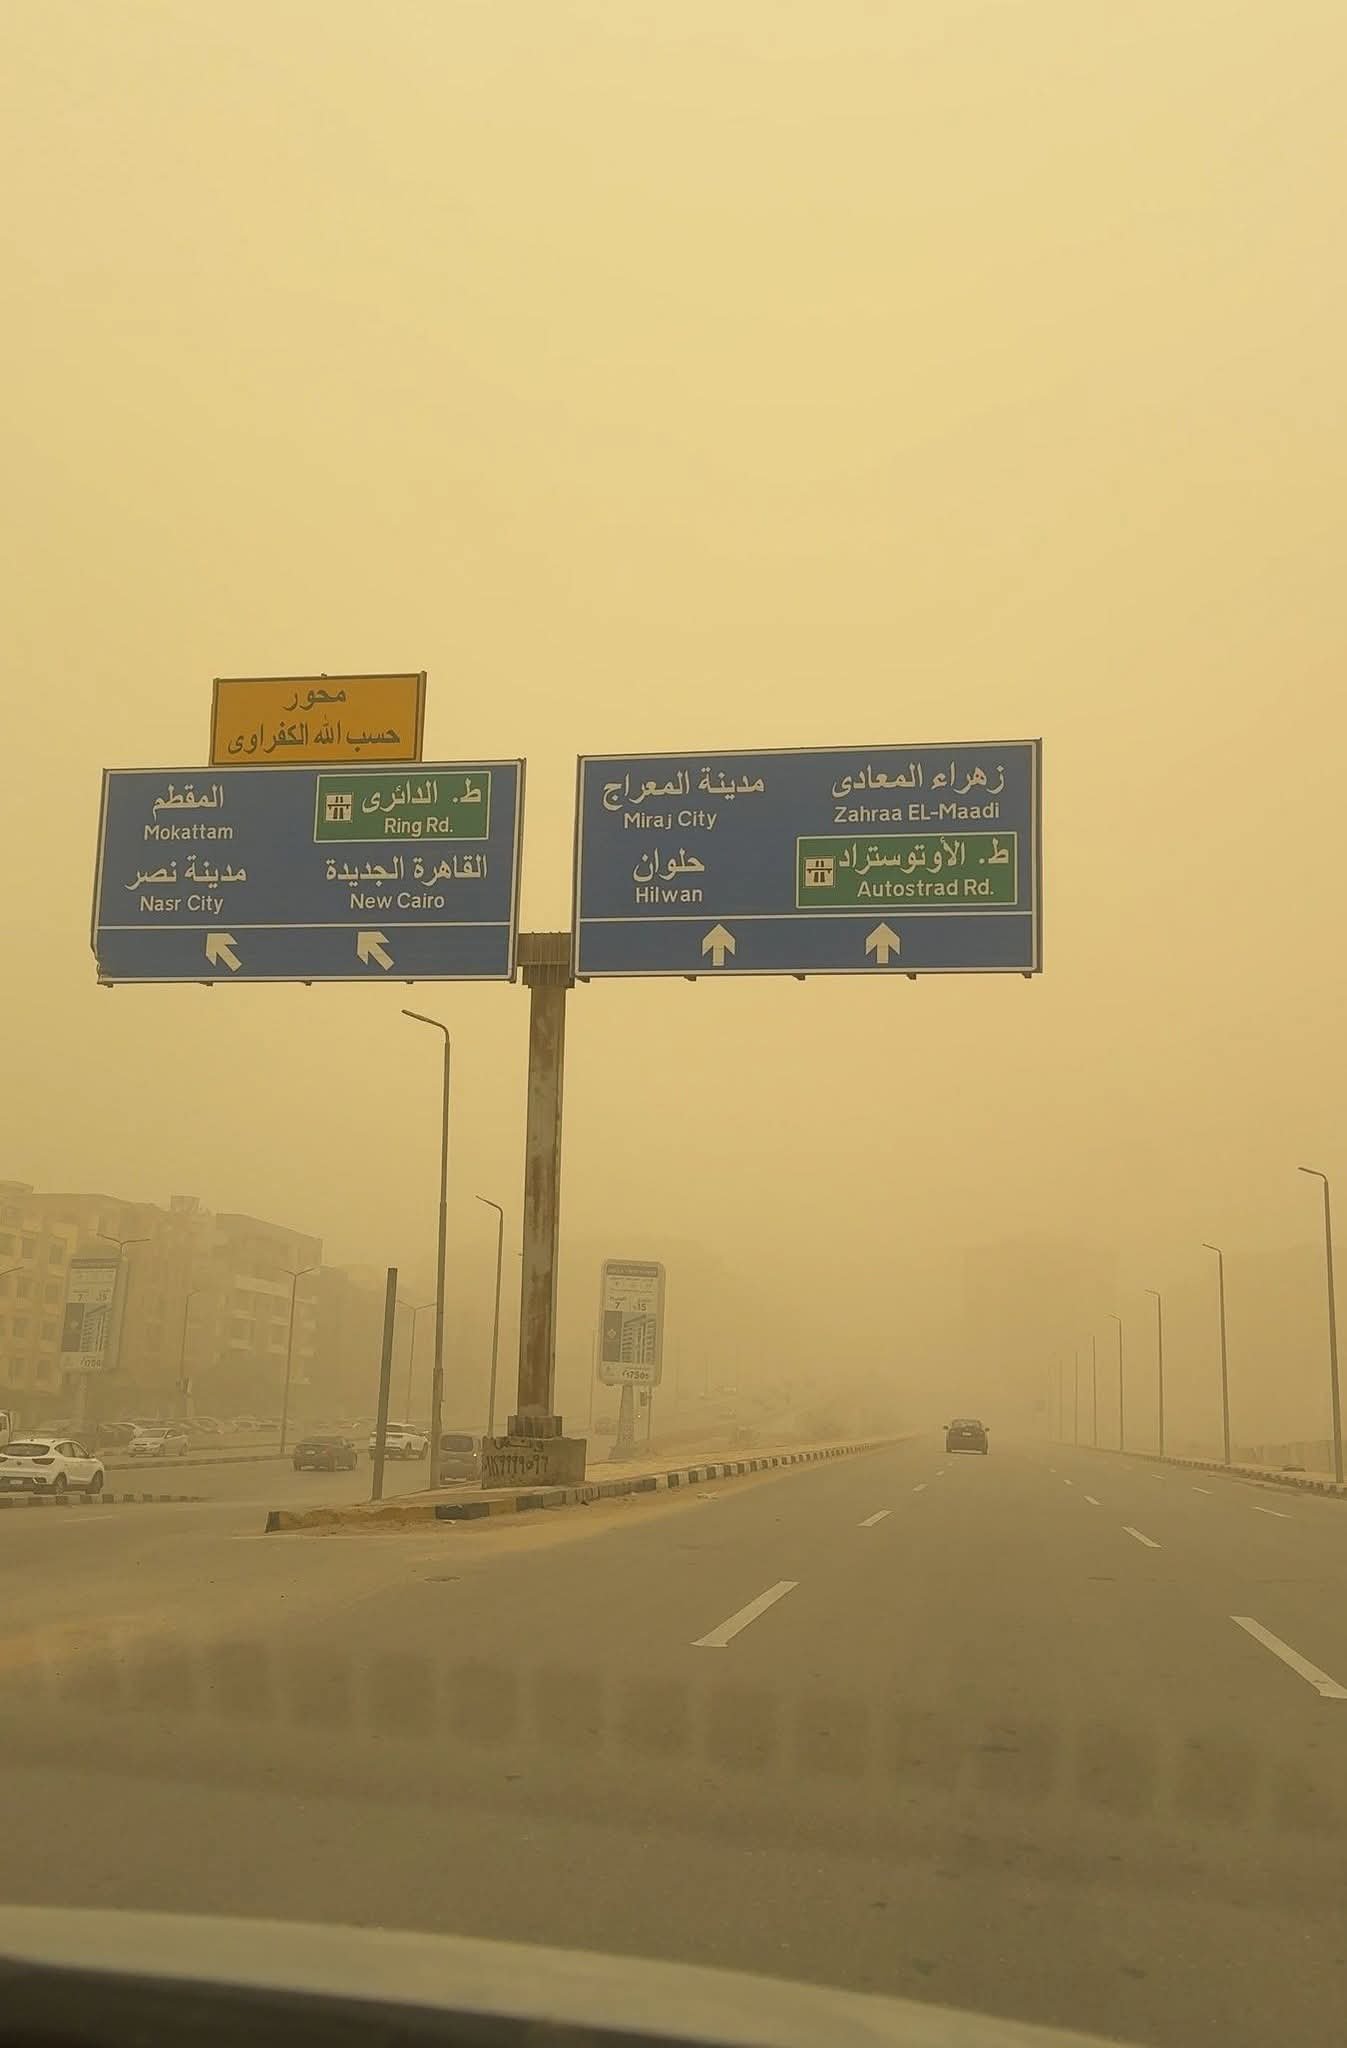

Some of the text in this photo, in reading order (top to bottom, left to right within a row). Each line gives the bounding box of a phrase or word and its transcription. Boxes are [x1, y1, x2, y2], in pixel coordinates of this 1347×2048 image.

[284, 687, 346, 711] محور
[314, 714, 340, 744] الله
[347, 730, 400, 752] حسب
[604, 767, 764, 813] مدينة المعراج
[832, 762, 1004, 797] زهراء المعادى
[153, 784, 223, 820] المقطم
[362, 781, 437, 813] الدائرى
[624, 811, 716, 829] Miraj City
[835, 803, 999, 822] Zahraa EL-Maadi
[145, 824, 232, 840] Mokattam
[384, 817, 453, 837] Ring Rd.
[634, 848, 704, 881] حلوان
[839, 836, 965, 873] الأوتوستراد
[125, 855, 246, 890] مدينة نصر
[326, 855, 487, 886] القاهرة الجديدة
[637, 887, 702, 903] Hilwan
[858, 879, 993, 897] Autostrad Rd.
[141, 895, 223, 914] Nasr City
[351, 893, 444, 908] New Cairo
